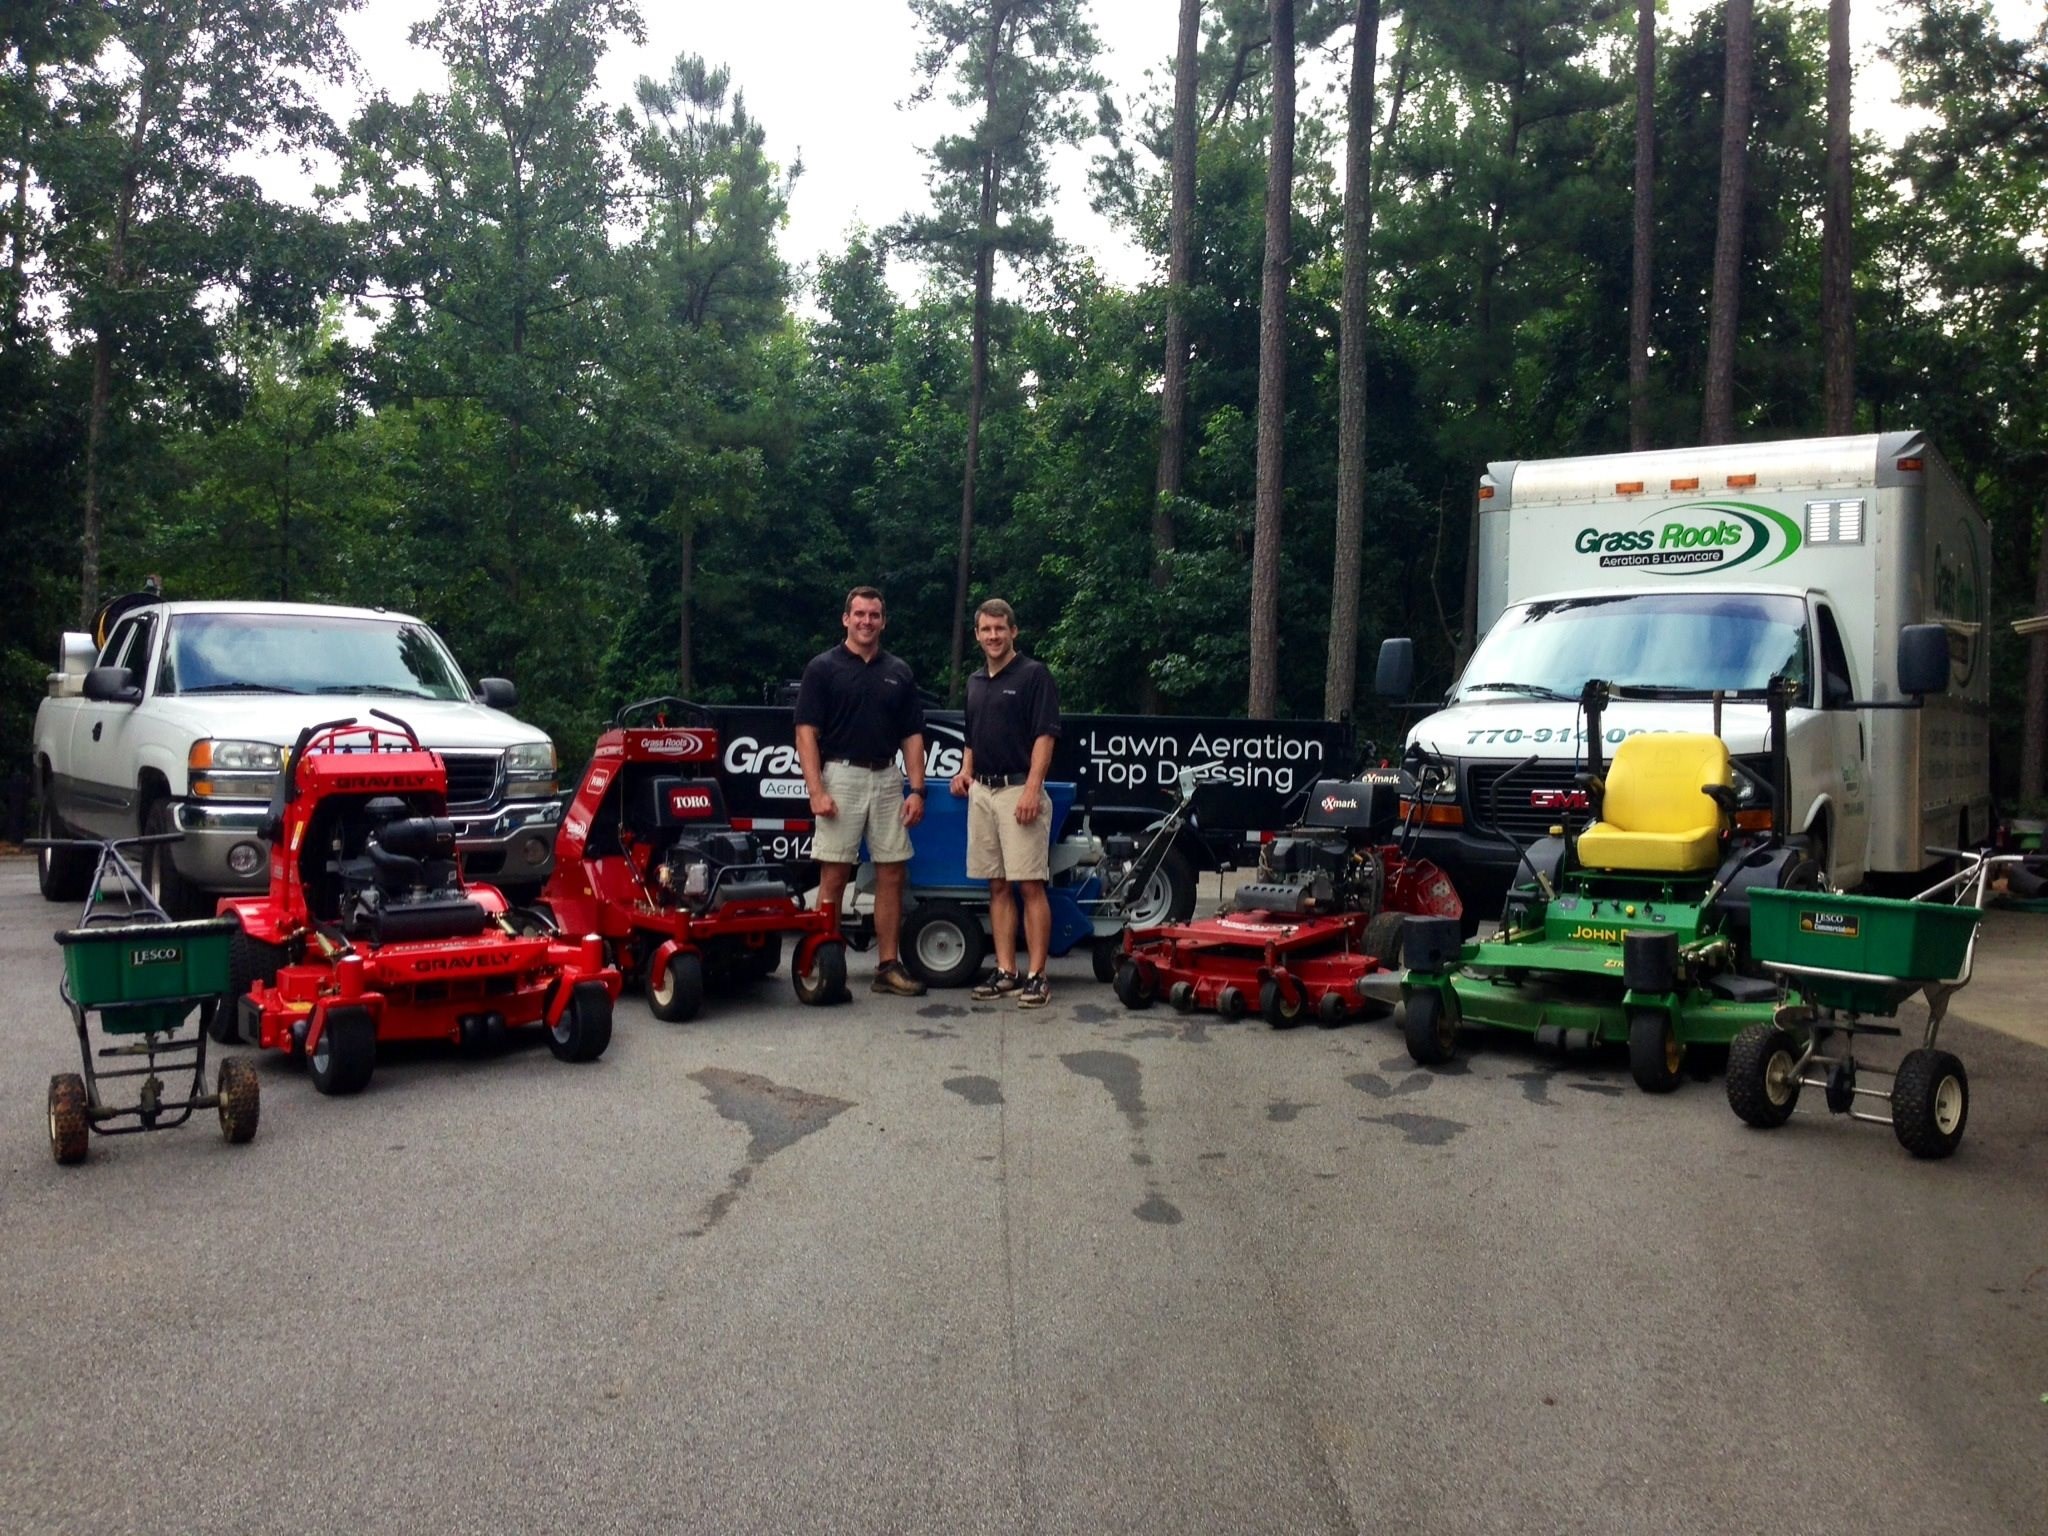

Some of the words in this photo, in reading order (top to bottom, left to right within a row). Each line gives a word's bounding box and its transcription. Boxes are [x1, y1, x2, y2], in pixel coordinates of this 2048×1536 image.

[1575, 527, 1654, 553] Grass
[1659, 520, 1742, 549] Roots
[1602, 556, 1650, 567] Aeration
[1652, 555, 1660, 564] &
[1663, 552, 1721, 564] Lawncare
[1091, 731, 1178, 757] Lawn
[1188, 733, 1323, 761] Aeration
[1091, 758, 1147, 789] Top
[336, 775, 427, 789] GRAVELY
[674, 796, 709, 809] TORO
[1815, 912, 1844, 924] LESCO
[1573, 925, 1616, 941] JOHN
[134, 948, 177, 965] LESCO
[415, 952, 513, 972] GRAVELY
